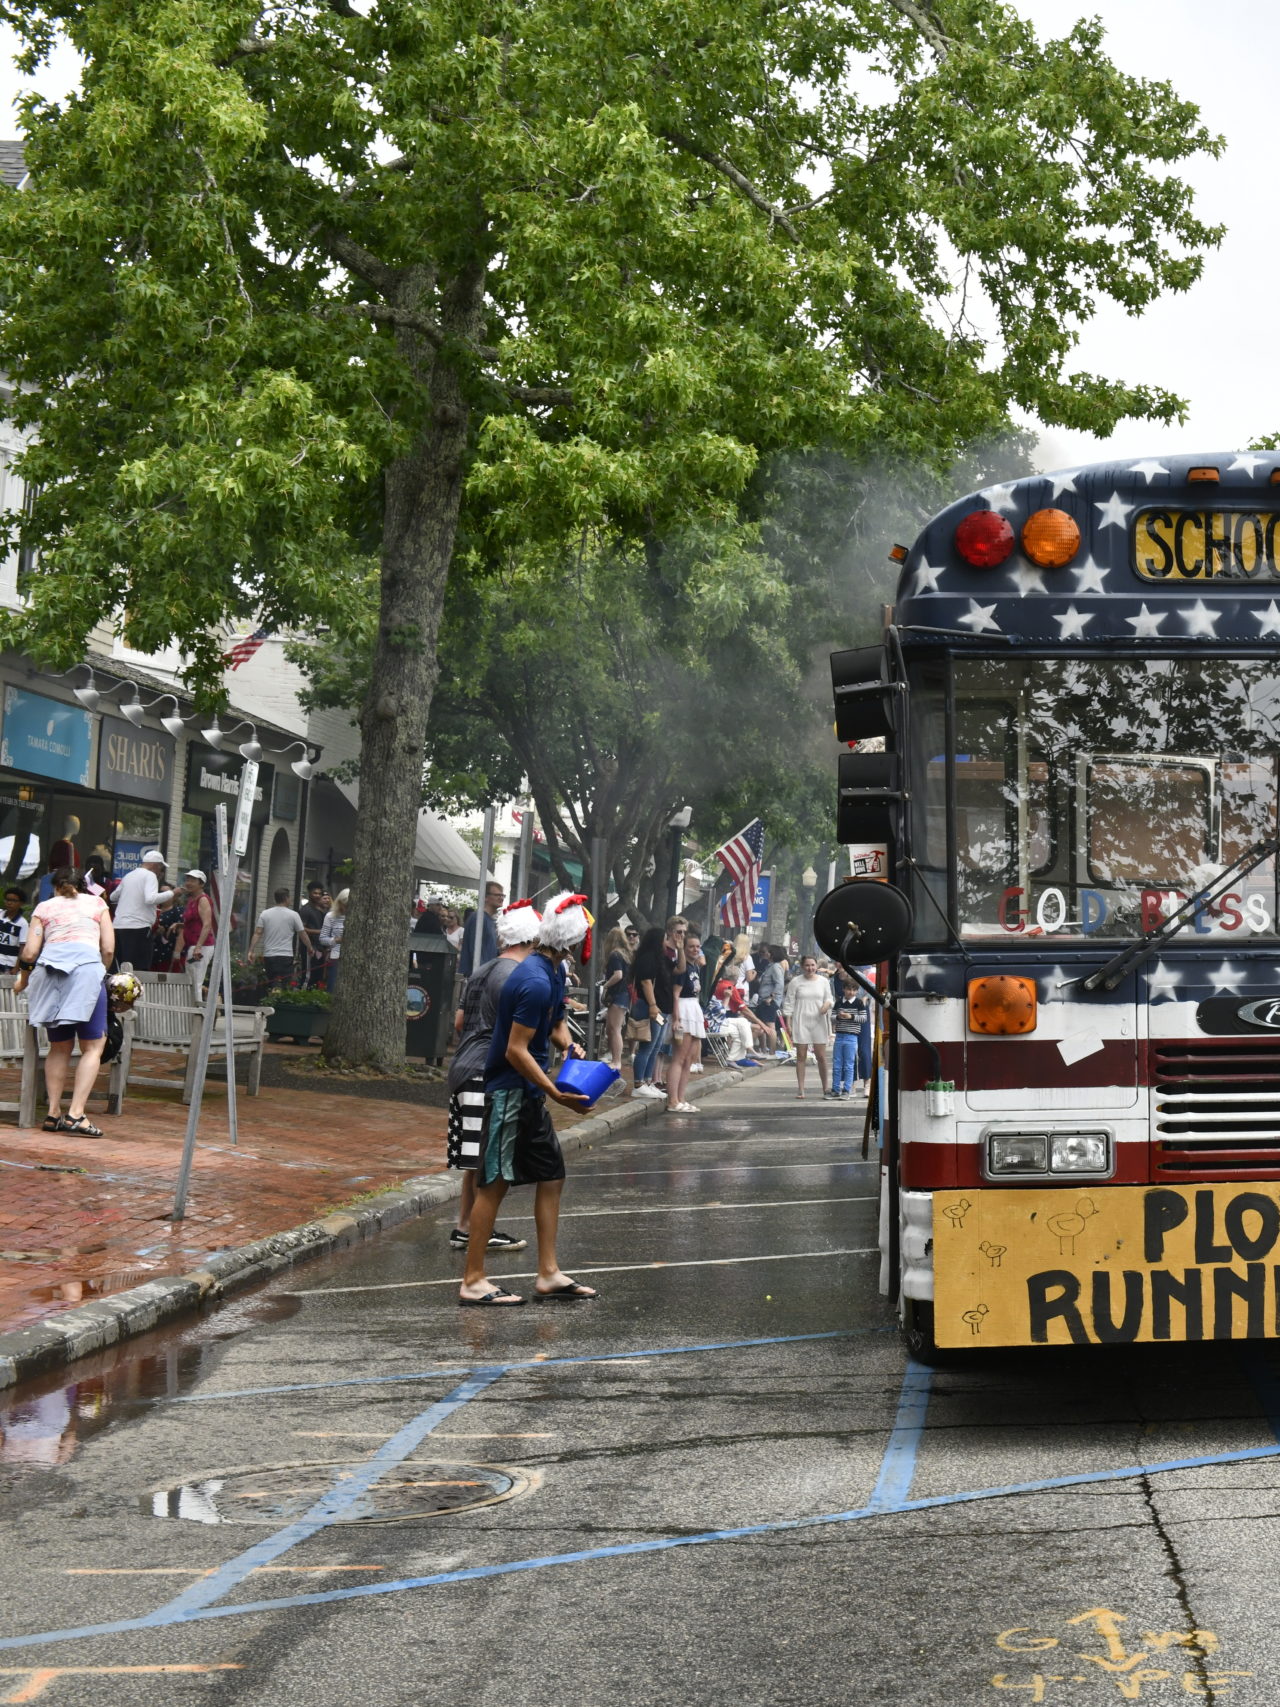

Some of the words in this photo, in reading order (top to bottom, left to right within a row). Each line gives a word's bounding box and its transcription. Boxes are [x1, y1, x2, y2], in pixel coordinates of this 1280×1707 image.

[107, 733, 167, 782] SHARI'S
[201, 767, 221, 791] Brown
[998, 886, 1106, 932] GOD
[1140, 890, 1270, 934] BLESS
